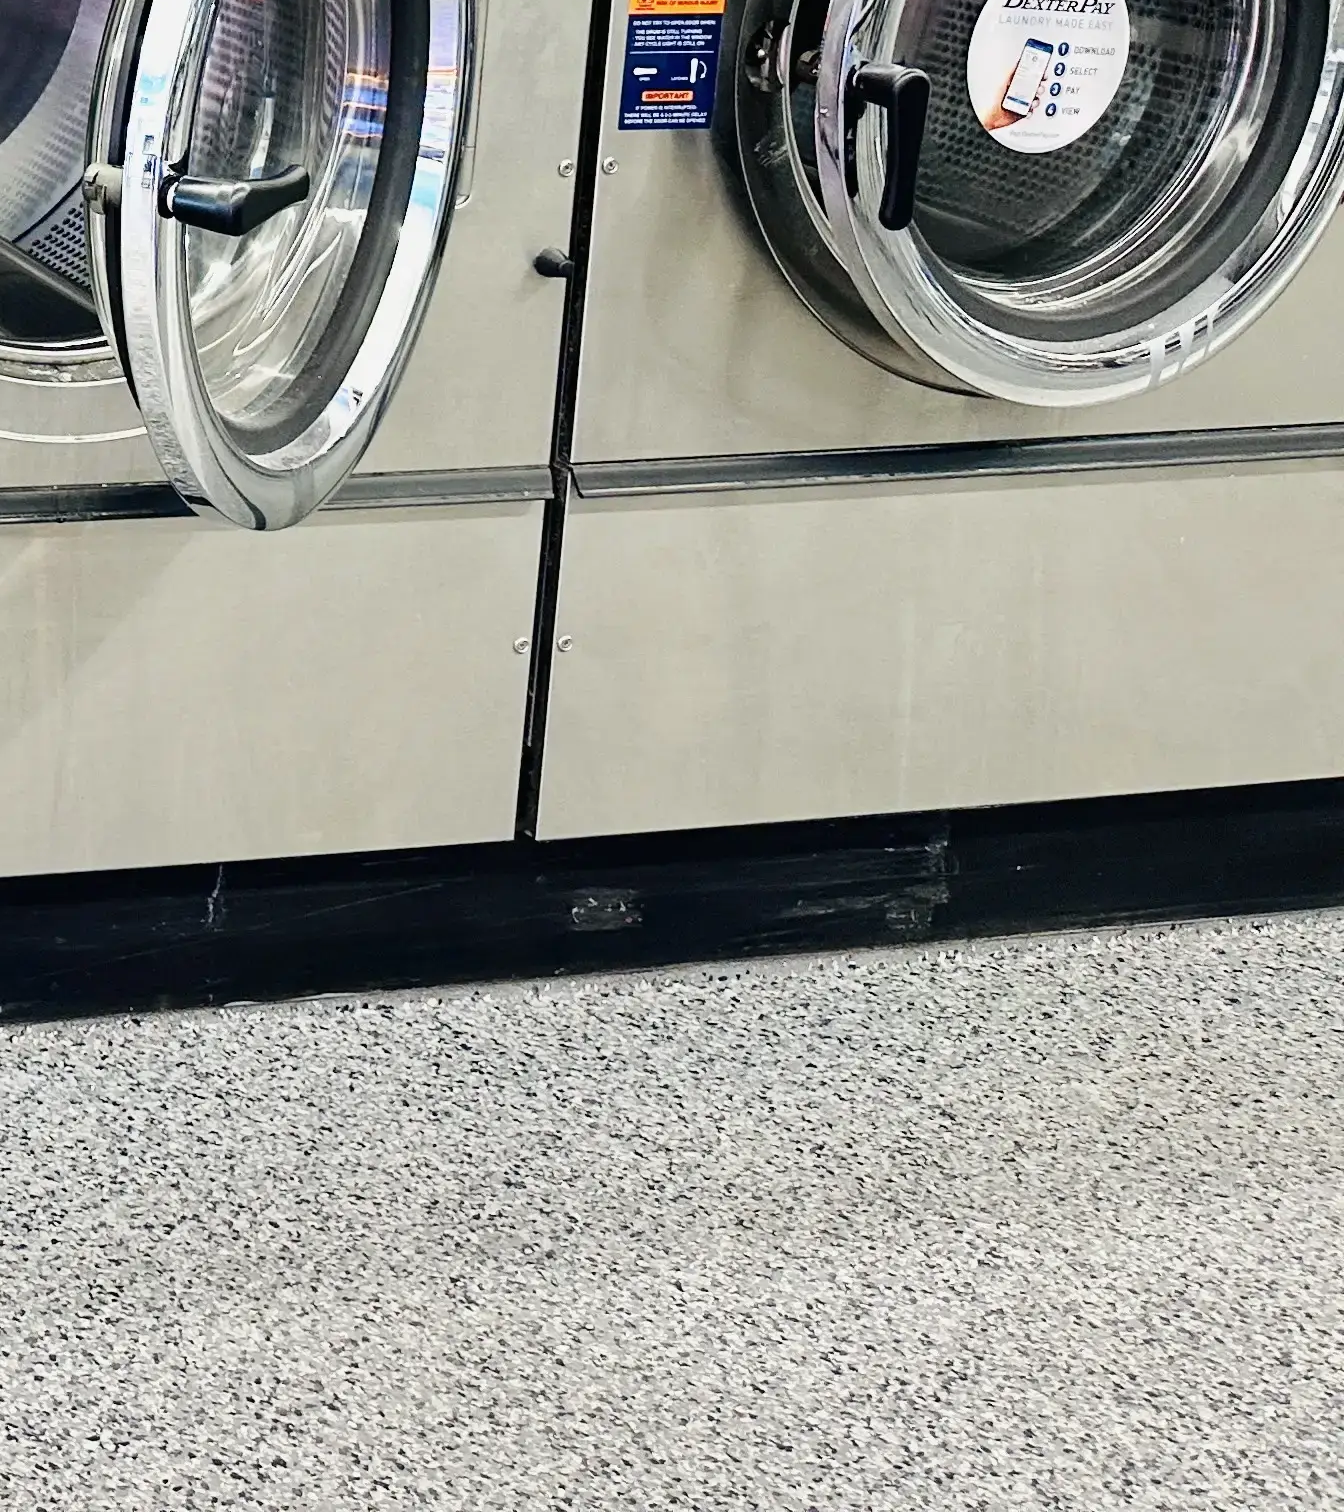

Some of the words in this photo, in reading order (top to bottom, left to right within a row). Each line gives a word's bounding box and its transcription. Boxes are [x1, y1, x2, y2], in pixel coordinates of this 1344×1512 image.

[999, 14, 1051, 28] LAUNDRY
[1056, 20, 1084, 29] MADE
[1074, 47, 1115, 56] DOWNLOAD
